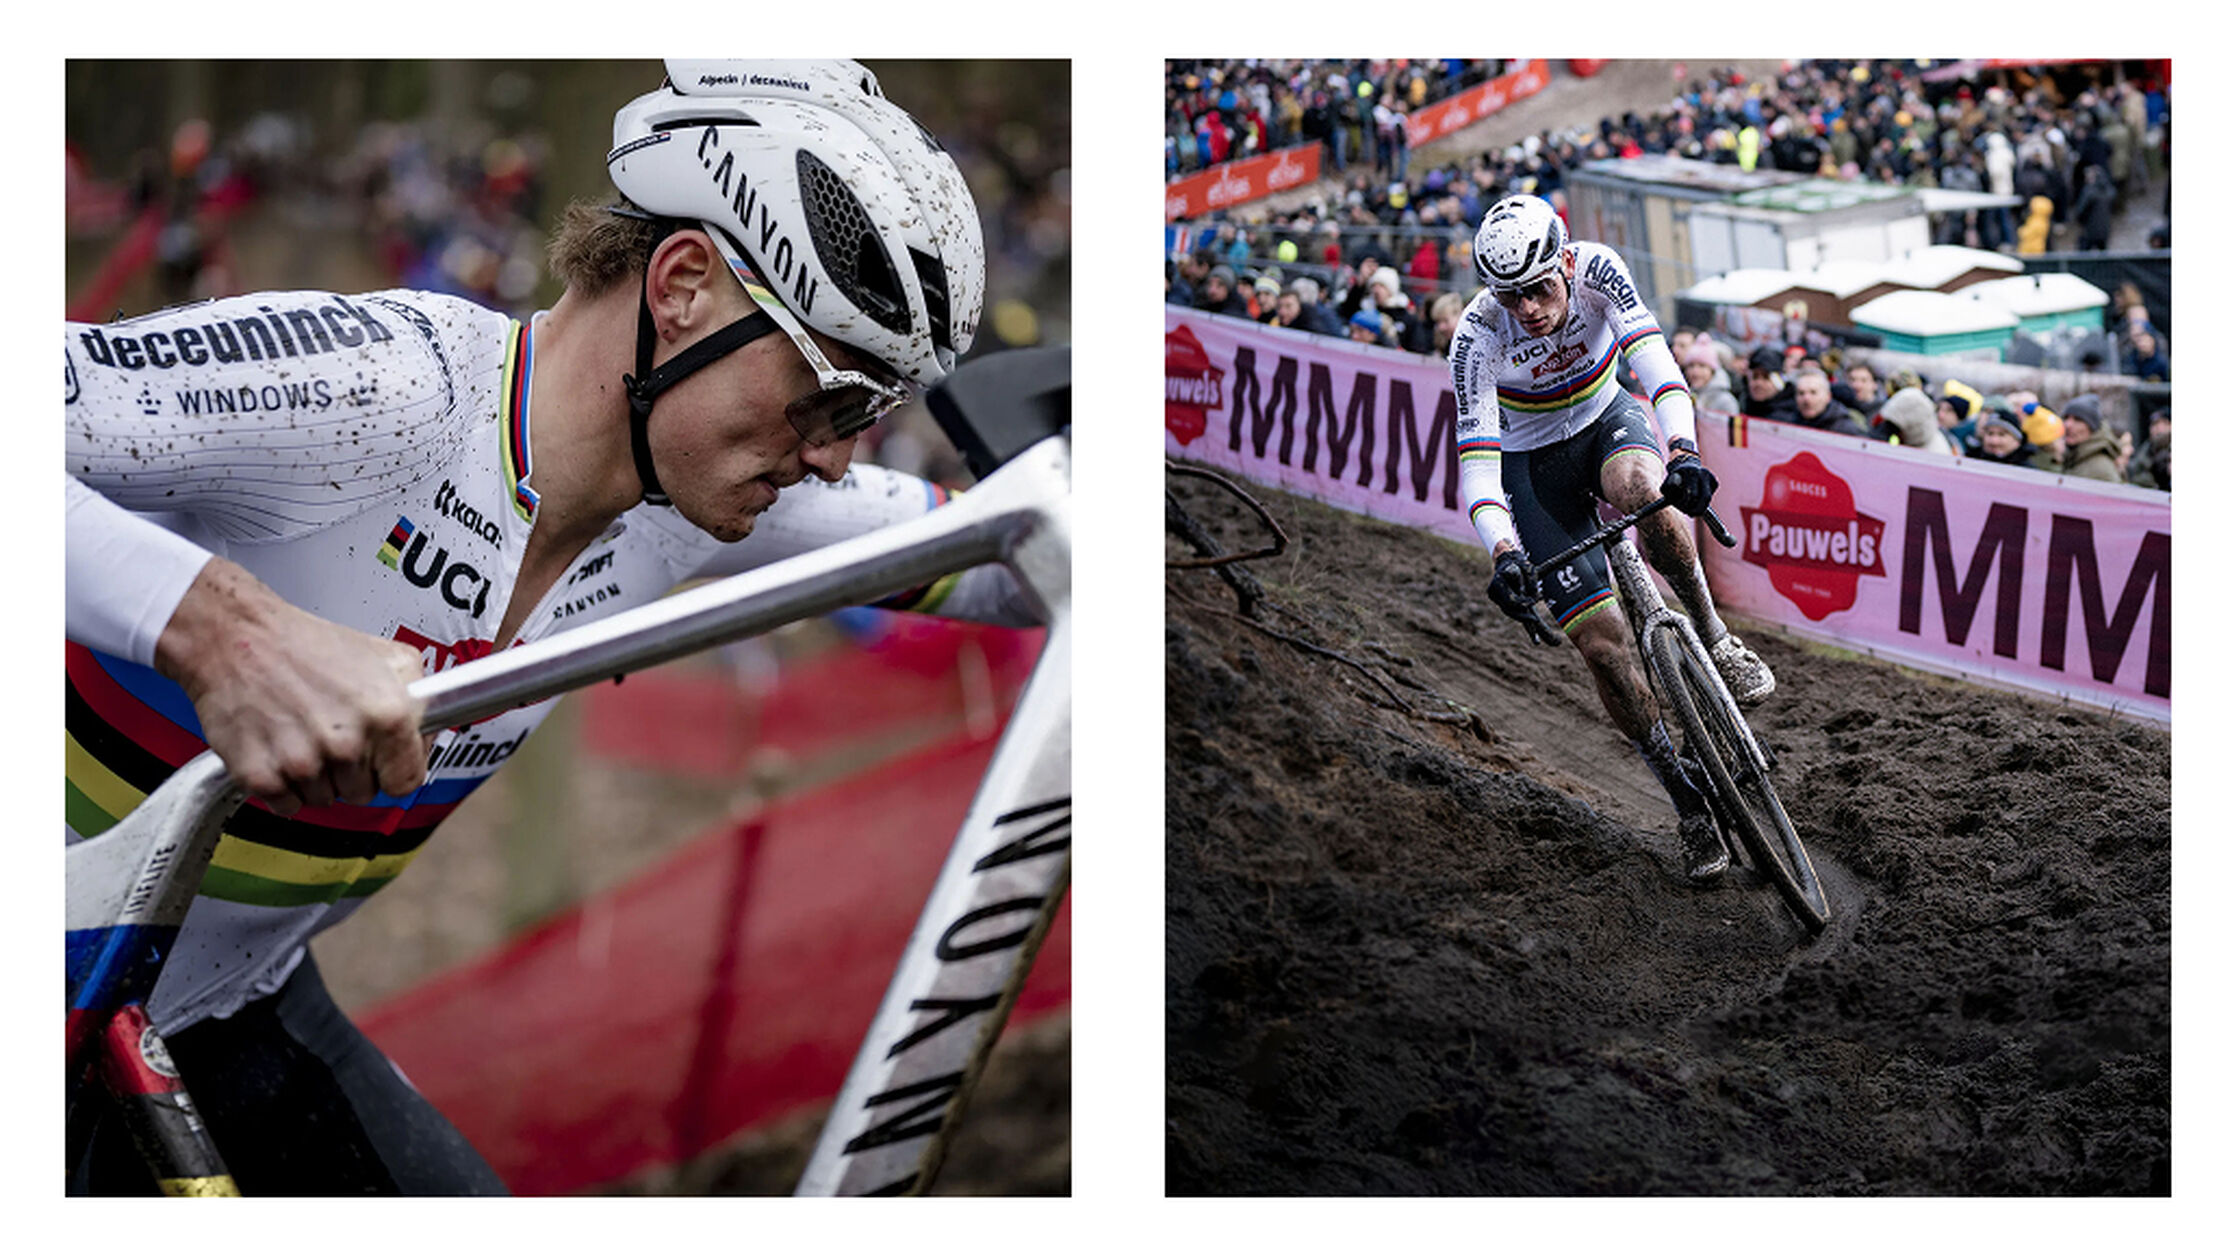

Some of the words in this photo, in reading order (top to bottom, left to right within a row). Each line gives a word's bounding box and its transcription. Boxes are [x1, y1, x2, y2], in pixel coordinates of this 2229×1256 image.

[697, 126, 819, 317] CANYON
[1585, 254, 1638, 310] Alpecin
[79, 295, 395, 370] deceuninck
[1517, 342, 1548, 364] UCI
[176, 380, 333, 415] WINDOWS
[1165, 369, 1219, 405] uwels
[1789, 480, 1827, 498] SAUCES
[1750, 511, 1877, 568] Pauwels
[401, 530, 491, 619] UCI
[553, 583, 622, 619] CANYON
[842, 796, 1072, 1198] NYON
